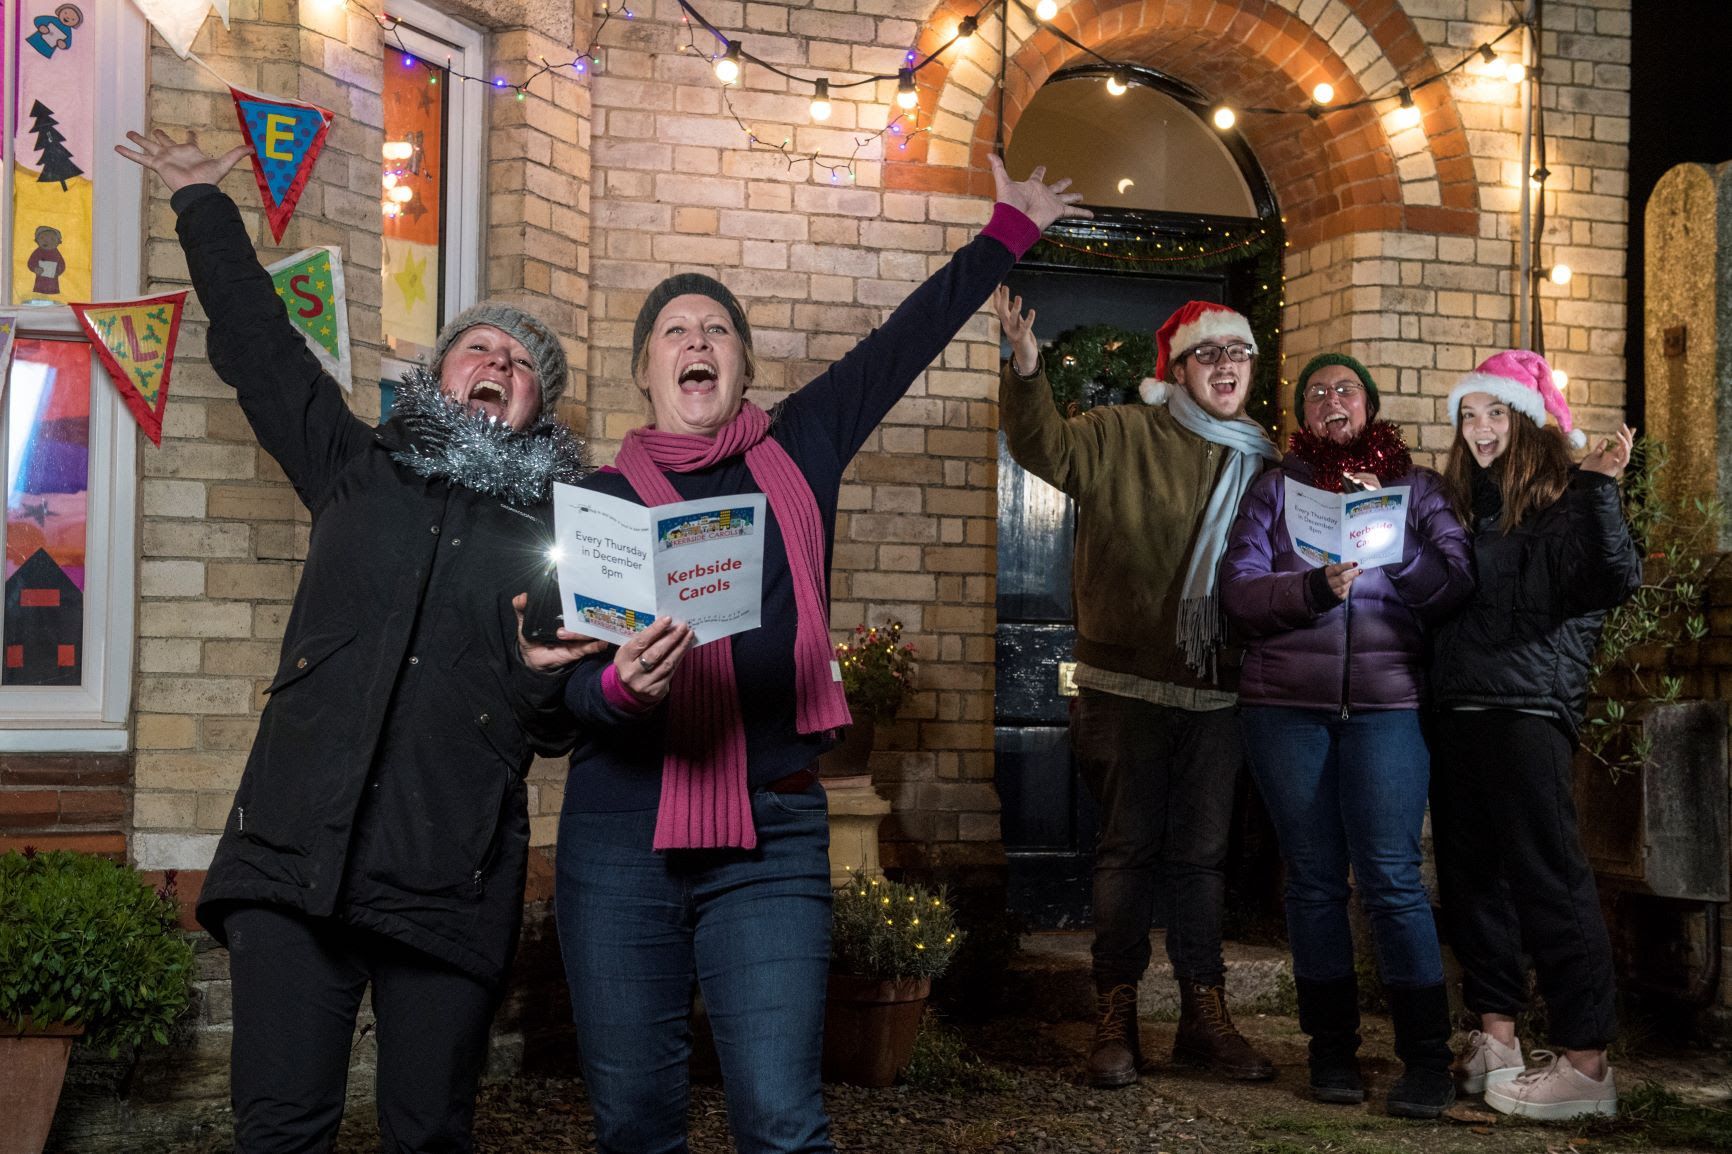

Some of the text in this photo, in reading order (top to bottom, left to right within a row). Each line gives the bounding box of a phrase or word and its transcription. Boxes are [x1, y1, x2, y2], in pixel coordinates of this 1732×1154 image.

[266, 114, 296, 162] E
[290, 274, 323, 318] S
[121, 315, 158, 362] L
[576, 530, 648, 560] Every Thursday
[582, 545, 643, 570] in December
[601, 565, 623, 579] 8pm
[667, 558, 743, 586] Kerbside
[678, 578, 731, 602] Carols
